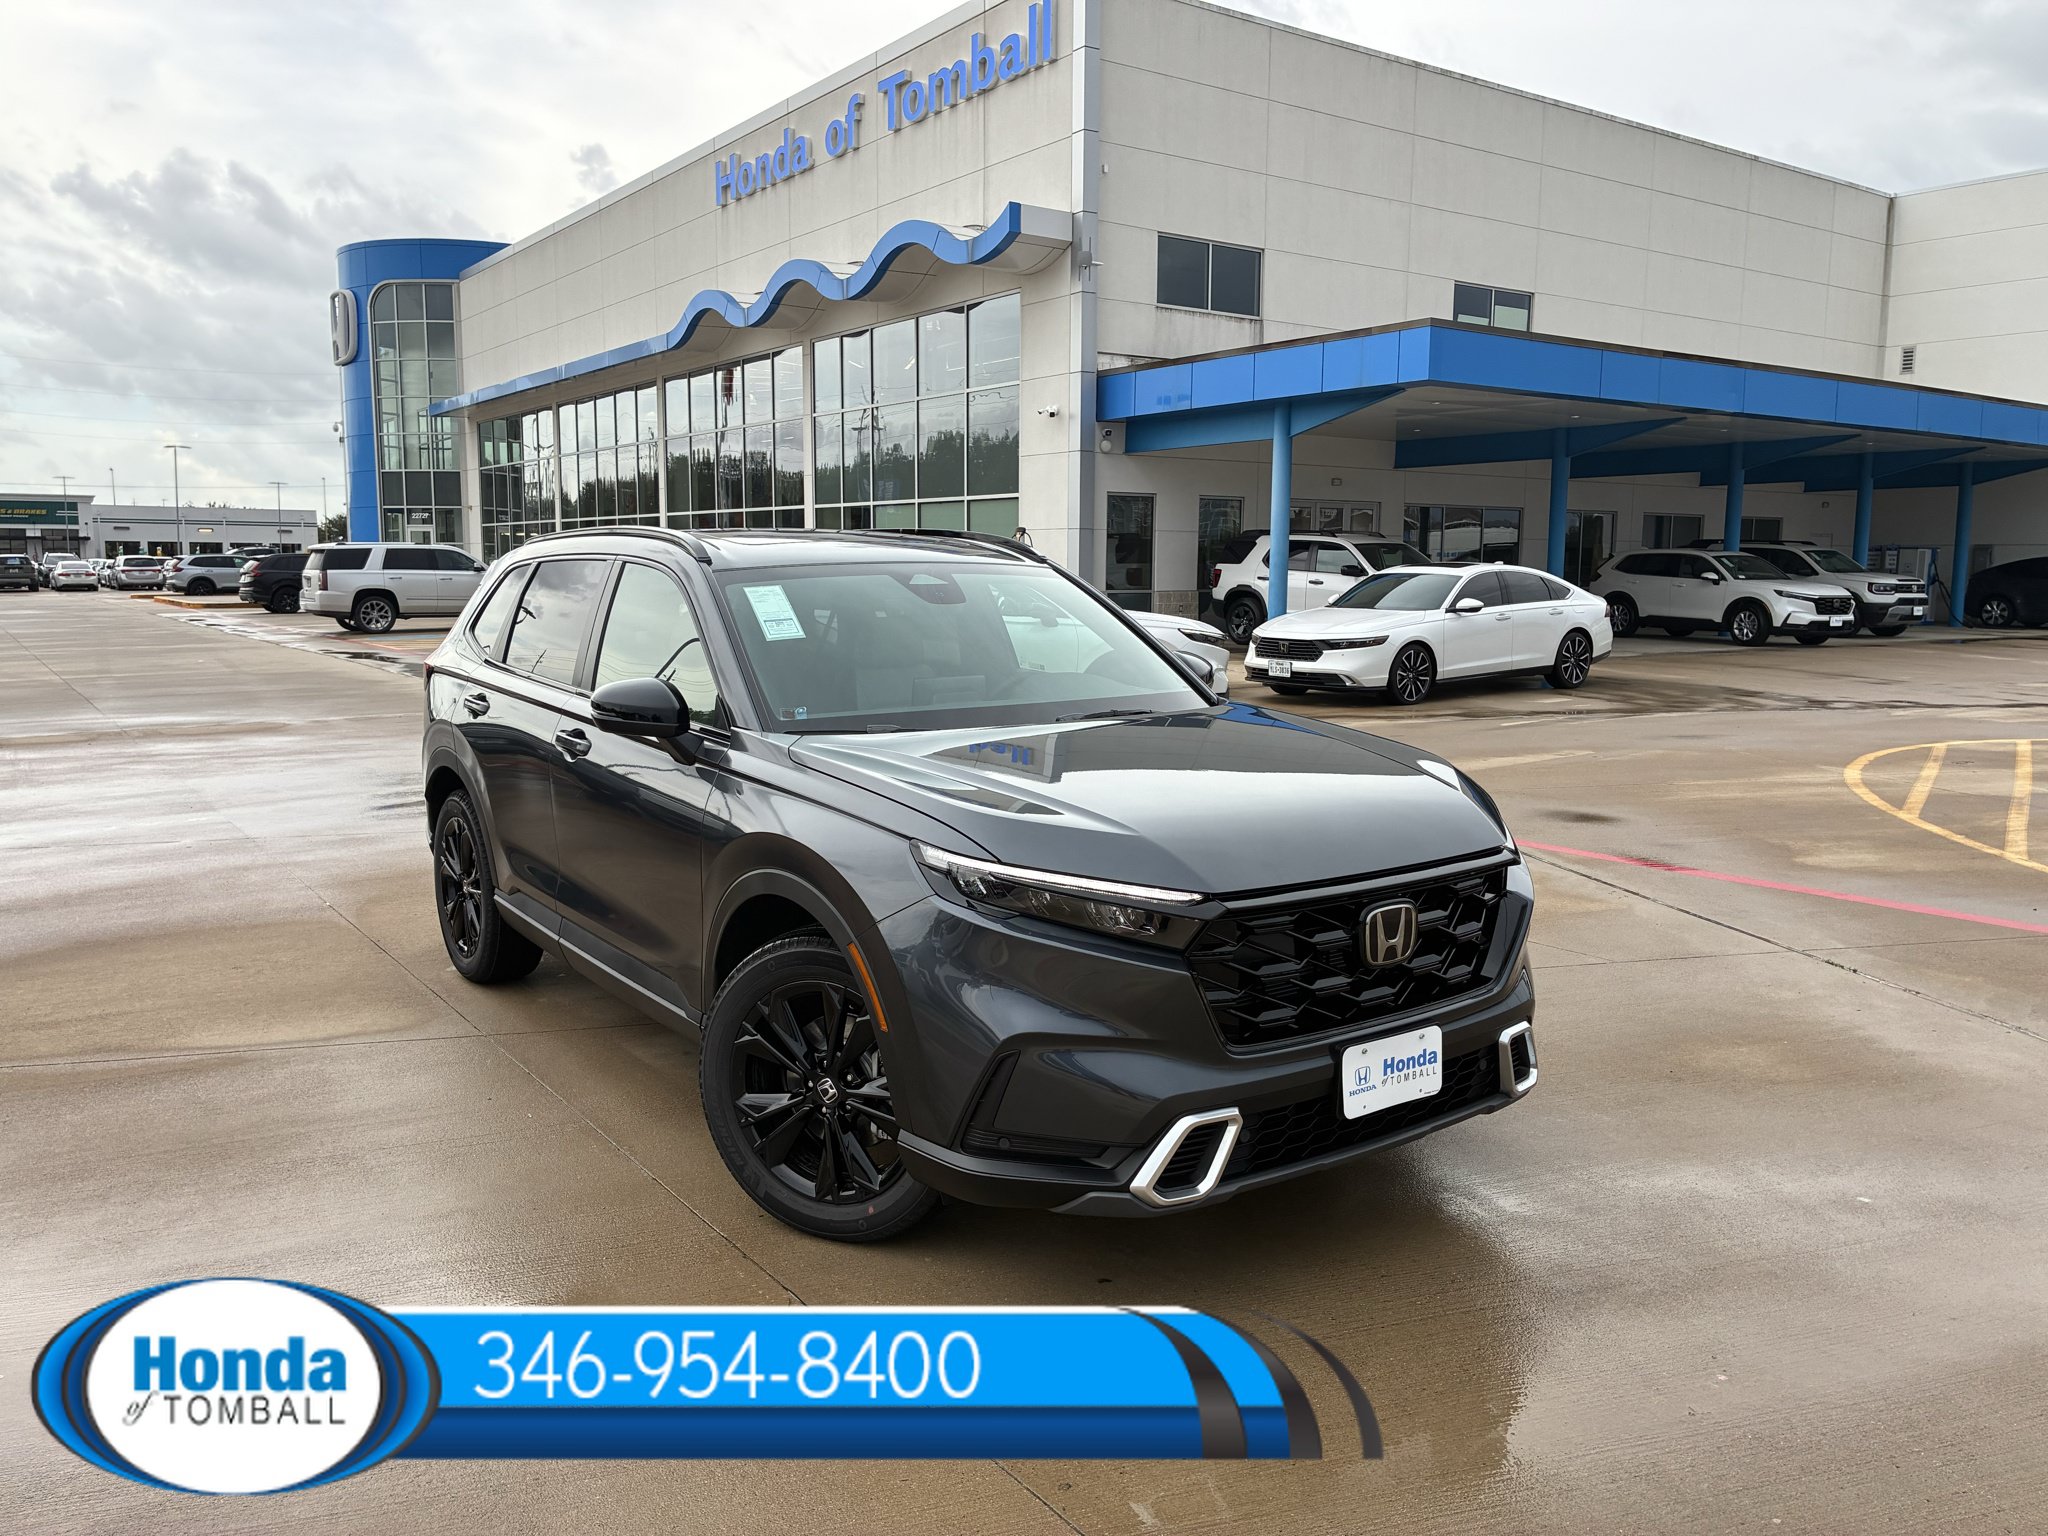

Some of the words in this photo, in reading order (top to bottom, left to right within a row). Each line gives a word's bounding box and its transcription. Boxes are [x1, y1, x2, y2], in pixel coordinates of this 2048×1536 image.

[715, 128, 813, 206] Honda
[825, 92, 864, 157] of
[878, 0, 1054, 132] Tomball
[1383, 1048, 1438, 1076] Honda
[1390, 1066, 1438, 1086] TOMBALL
[1349, 1084, 1377, 1097] HONDA
